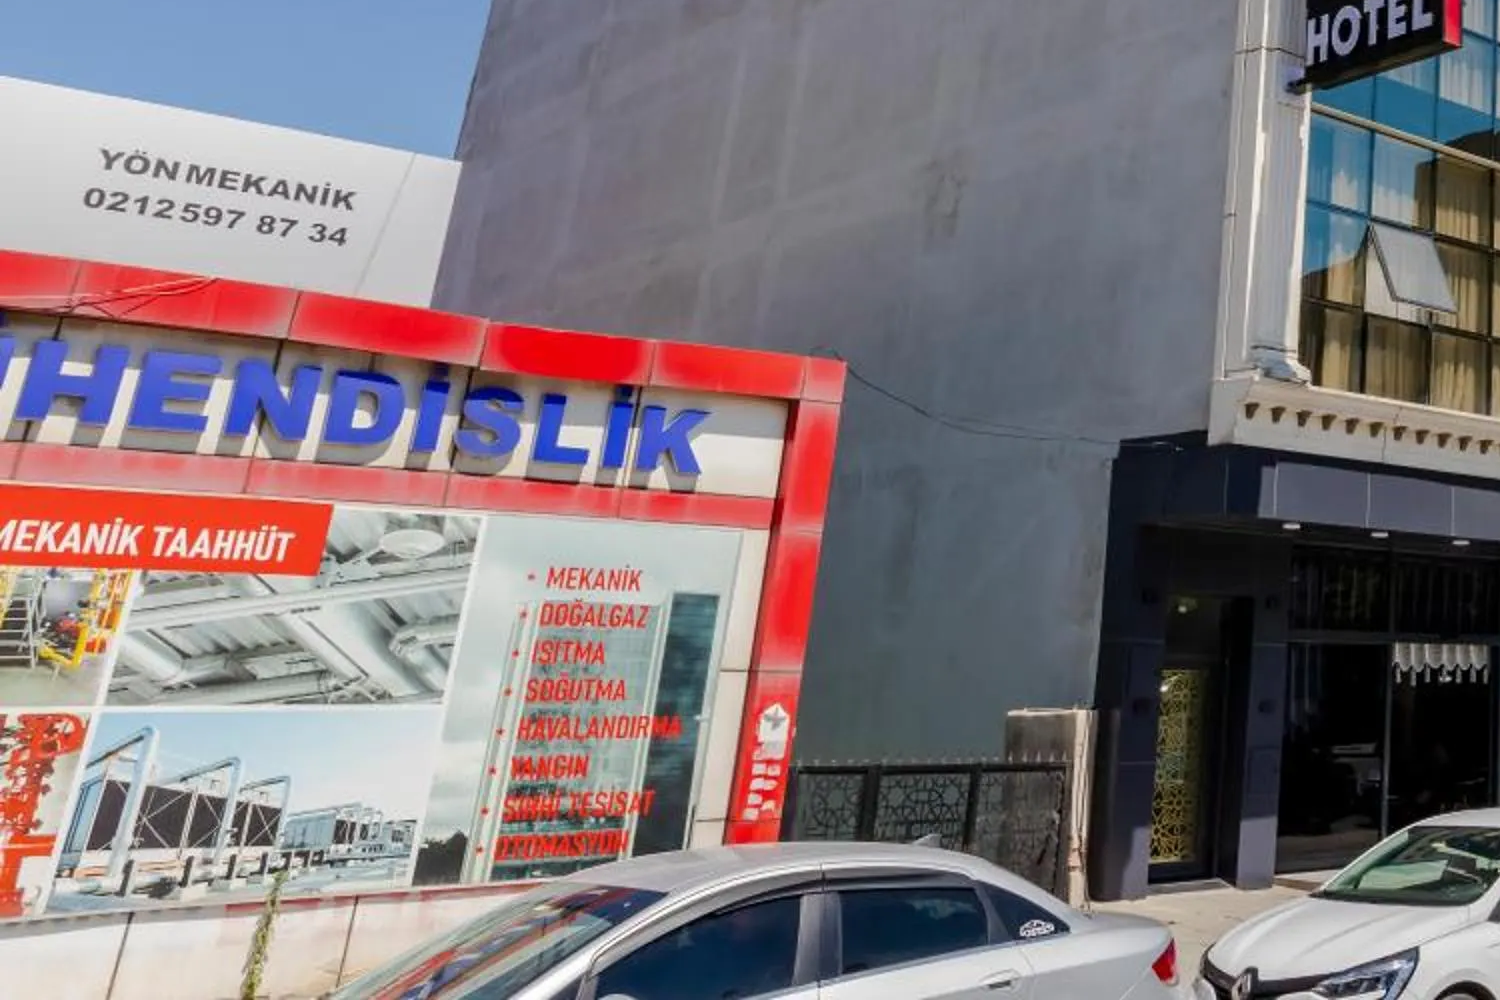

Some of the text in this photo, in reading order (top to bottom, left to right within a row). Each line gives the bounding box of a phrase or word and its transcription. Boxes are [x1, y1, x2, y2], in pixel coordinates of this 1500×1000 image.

[100, 148, 358, 211] YÖN MEKANİK
[84, 187, 348, 247] 0212 597 87 34
[0, 334, 713, 476] HENDİSLİK
[153, 525, 296, 562] TAAHHÜT
[546, 564, 643, 592] MEKANİK
[539, 598, 649, 628] DOĞALGAZ
[532, 639, 606, 665] ISITMA
[525, 672, 626, 703] SOĞUTMA
[517, 715, 682, 742] HAVALANDIRMA
[511, 754, 589, 780] YANGIN
